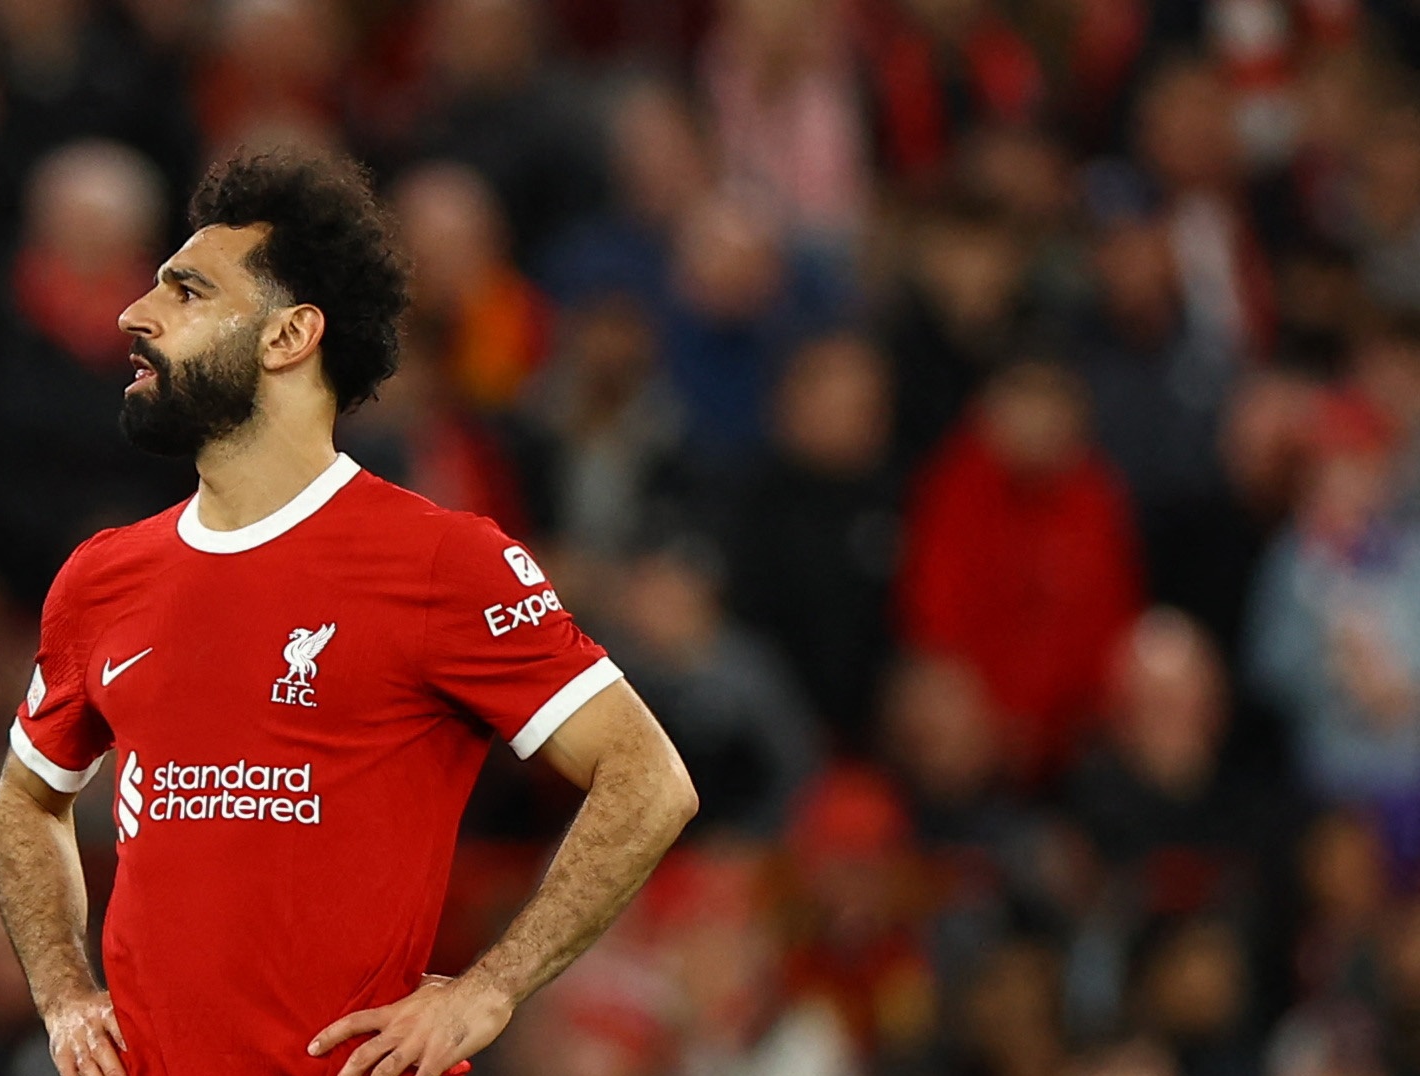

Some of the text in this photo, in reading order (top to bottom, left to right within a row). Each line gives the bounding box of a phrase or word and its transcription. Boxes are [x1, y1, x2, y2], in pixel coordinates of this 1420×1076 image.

[483, 589, 564, 637] Expe
[152, 759, 311, 793] standard
[149, 789, 320, 825] chartered
